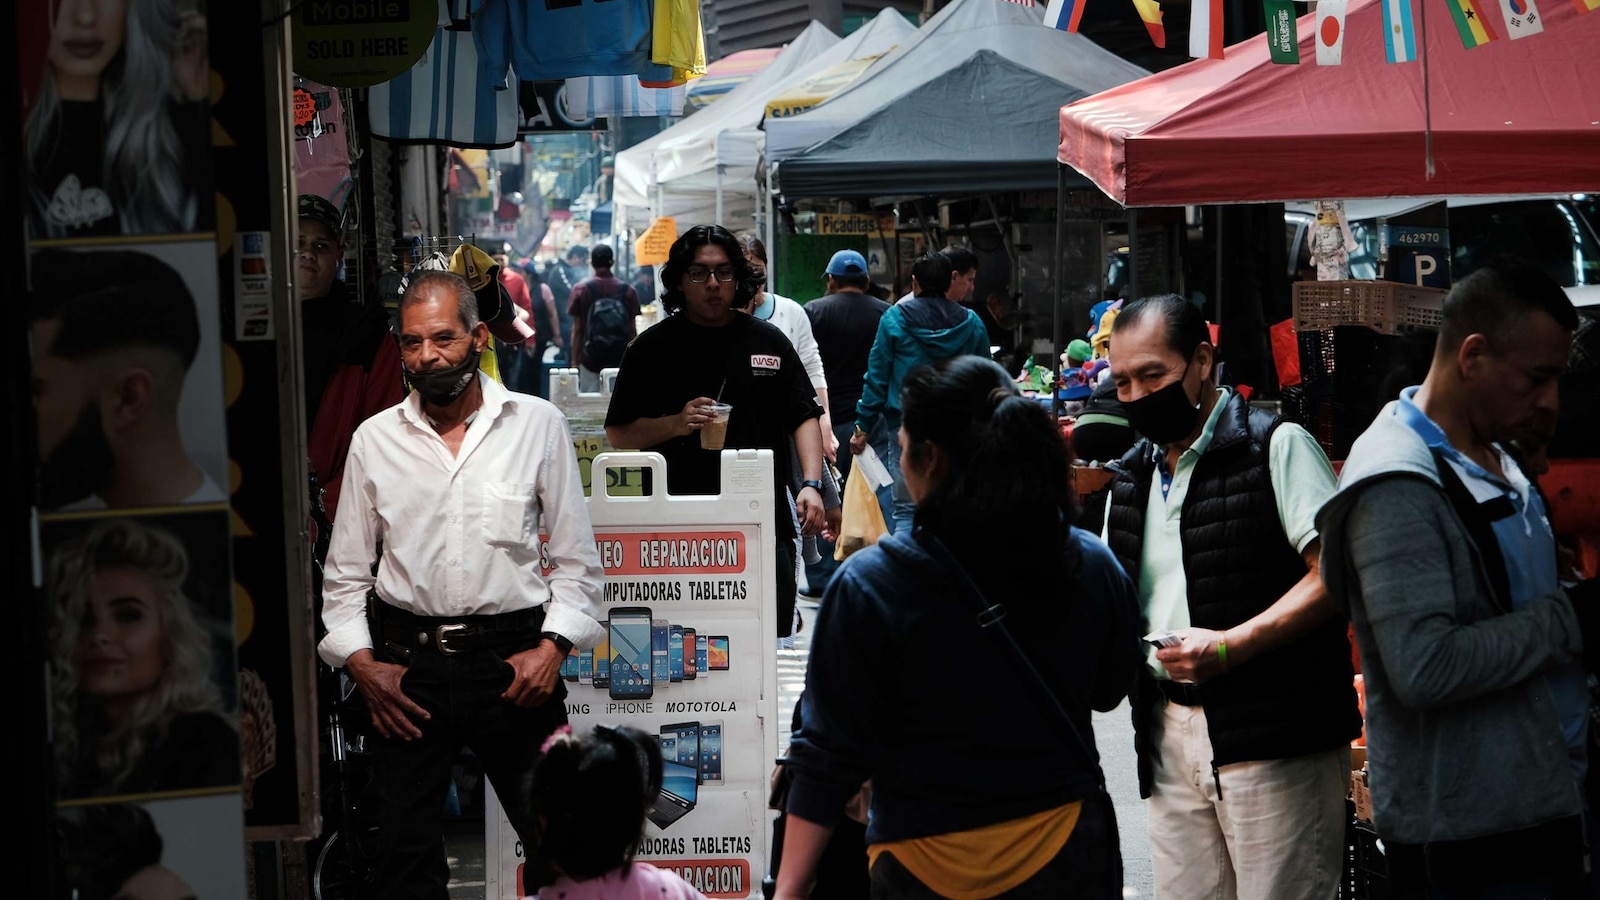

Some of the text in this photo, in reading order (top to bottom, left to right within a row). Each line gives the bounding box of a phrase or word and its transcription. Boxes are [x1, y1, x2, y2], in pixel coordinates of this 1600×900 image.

[312, 0, 400, 20] Mobile
[307, 37, 409, 59] SOLD HERE
[823, 216, 875, 233] Picaditas
[1399, 233, 1440, 243] 462970
[1414, 255, 1437, 286] P
[752, 357, 779, 367] NASA
[640, 538, 738, 568] REPARACION
[603, 580, 747, 602] MPUTADORAS TABLETAS
[606, 702, 653, 714] iPHONE
[665, 701, 737, 713] MOTOTOLA
[638, 836, 751, 855] ADORAS TABLETAS
